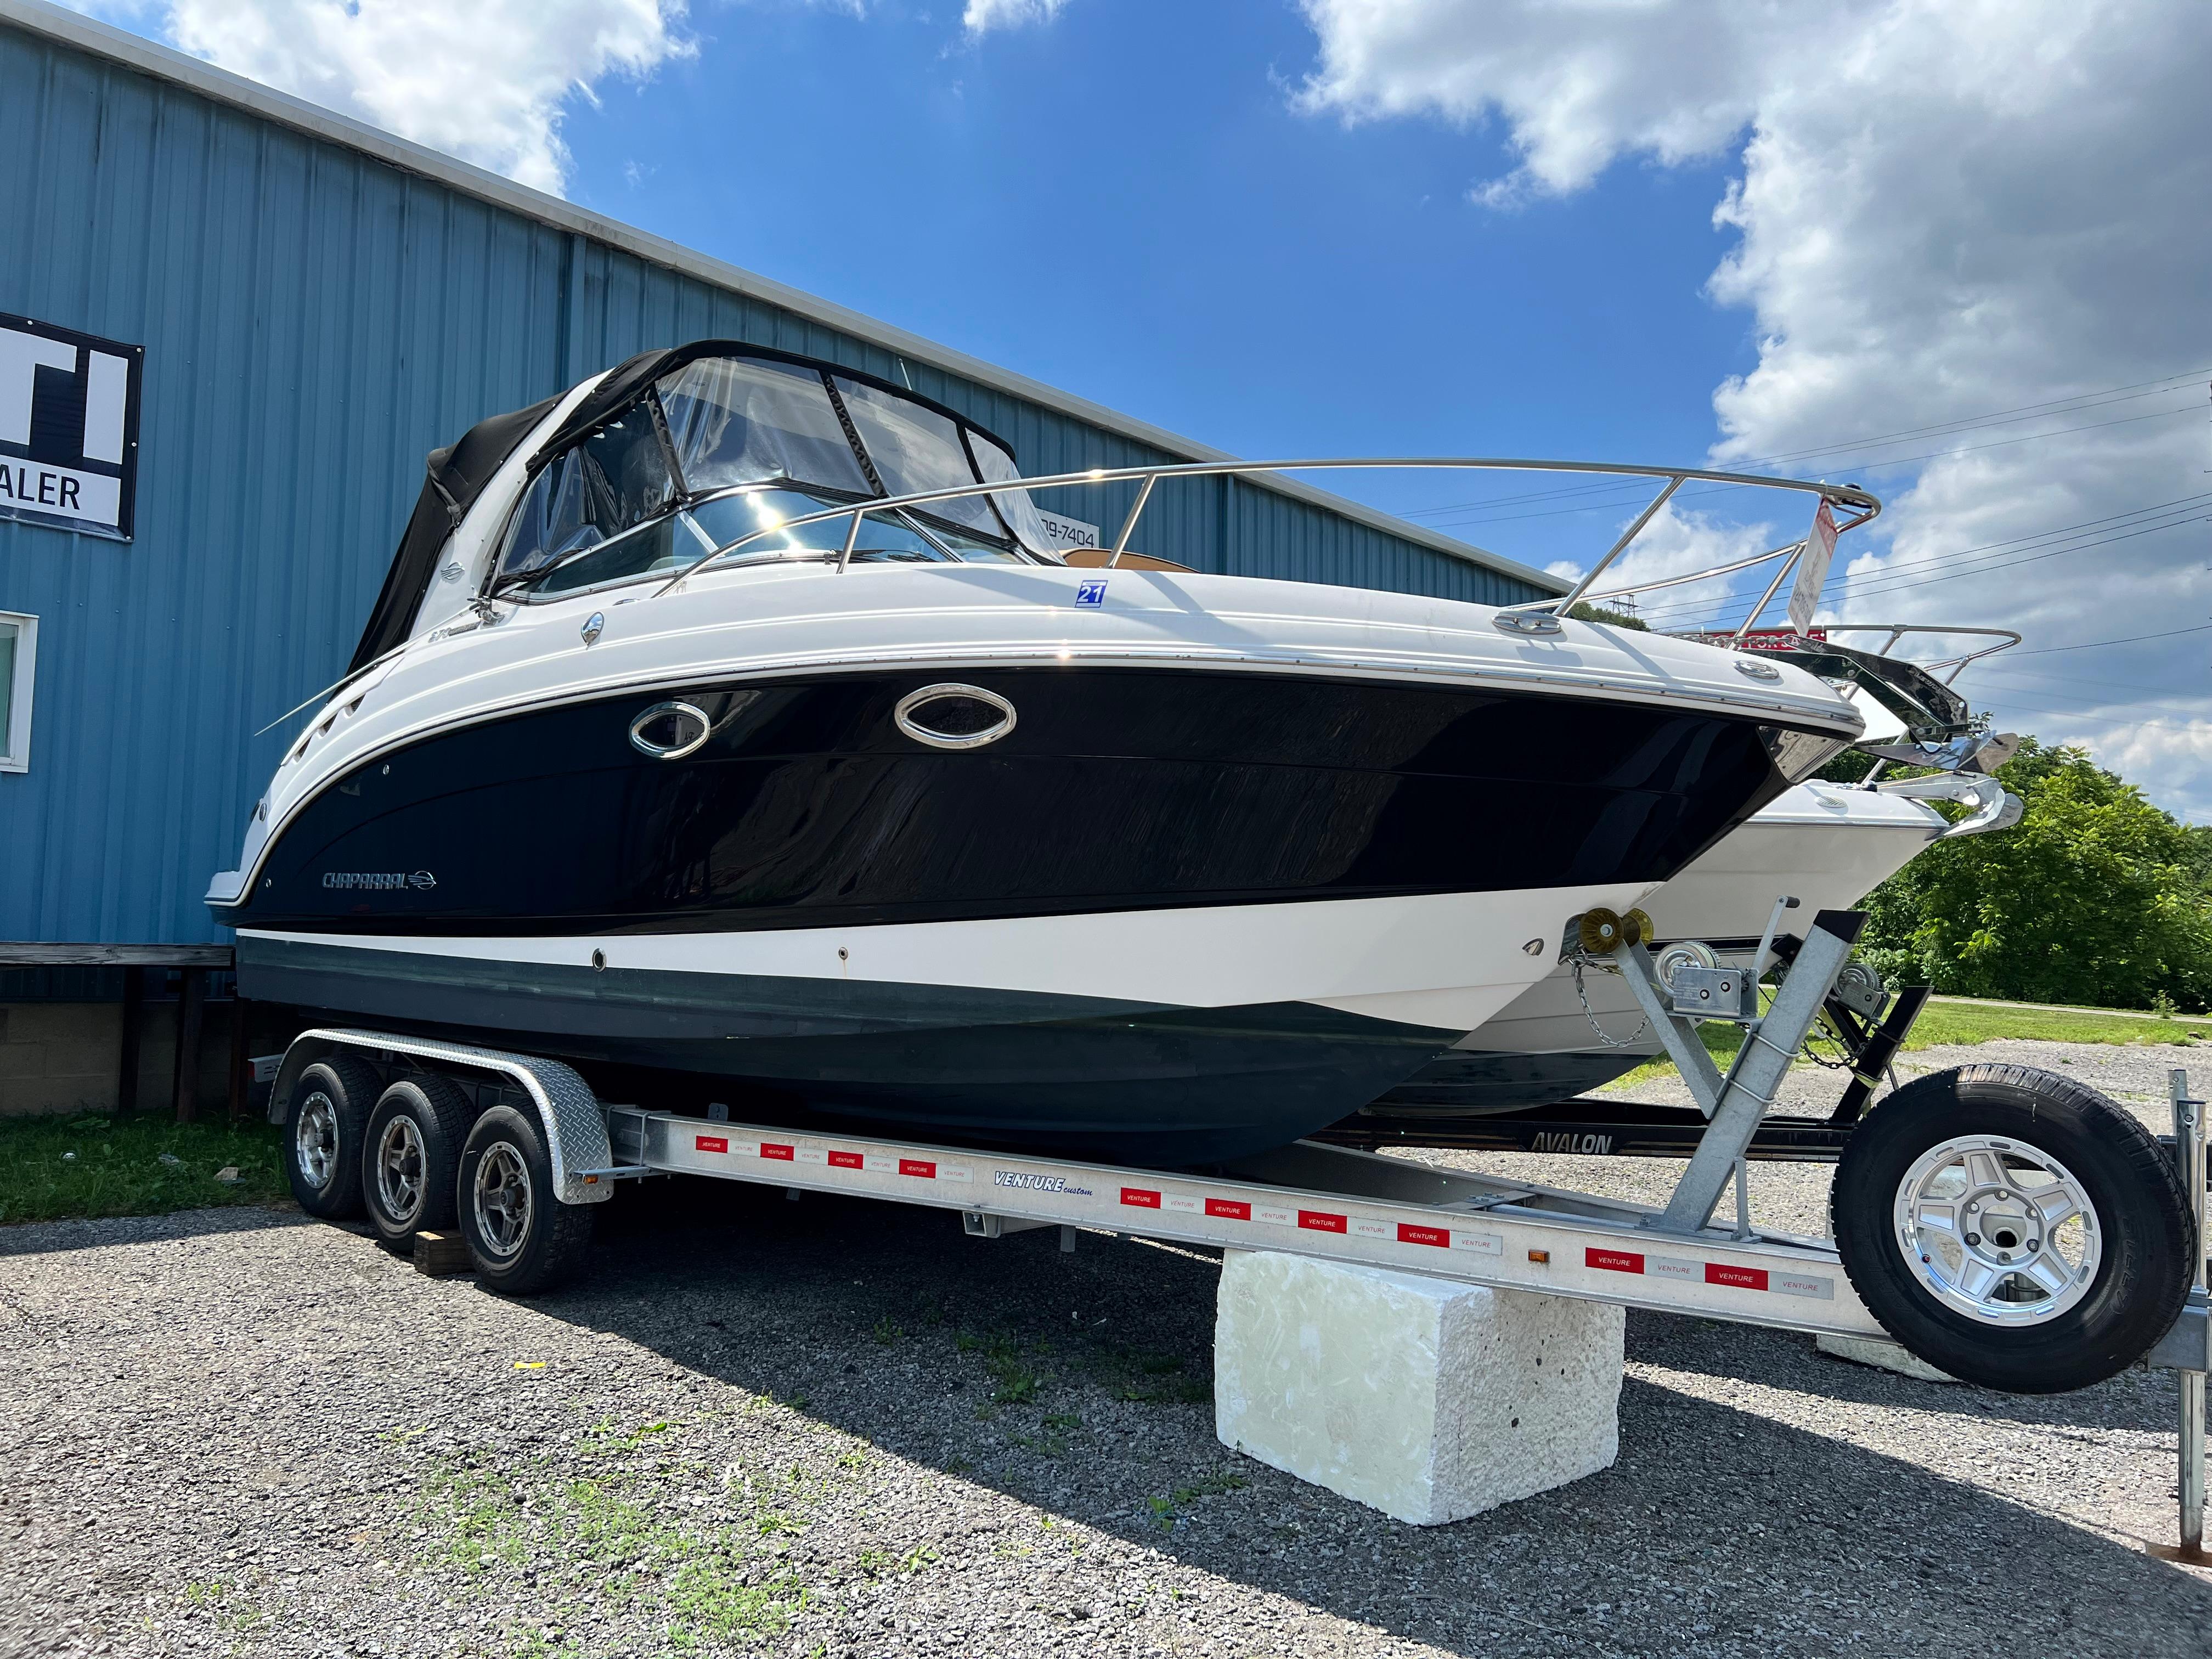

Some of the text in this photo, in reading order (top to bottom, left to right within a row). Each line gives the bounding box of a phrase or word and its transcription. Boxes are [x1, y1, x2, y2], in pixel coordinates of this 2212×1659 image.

[1077, 586, 1103, 602] 21
[322, 872, 408, 890] CHAPARRAL
[1531, 1132, 1612, 1154] AVALON
[944, 1170, 965, 1178] VENTURE
[994, 1170, 1093, 1197] VENTURE custom
[1170, 1200, 1195, 1208] VENTURE
[1215, 1206, 1240, 1215] VENTURE
[1261, 1212, 1287, 1220] VENTURE
[1308, 1219, 1336, 1227] VENTURE
[1358, 1225, 1386, 1234] VENTURE
[1409, 1232, 1437, 1241] VENTURE
[1462, 1239, 1491, 1248] VENTURE
[1598, 1257, 1819, 1291] VENTURE VENTURE VENTURE VENTURE
